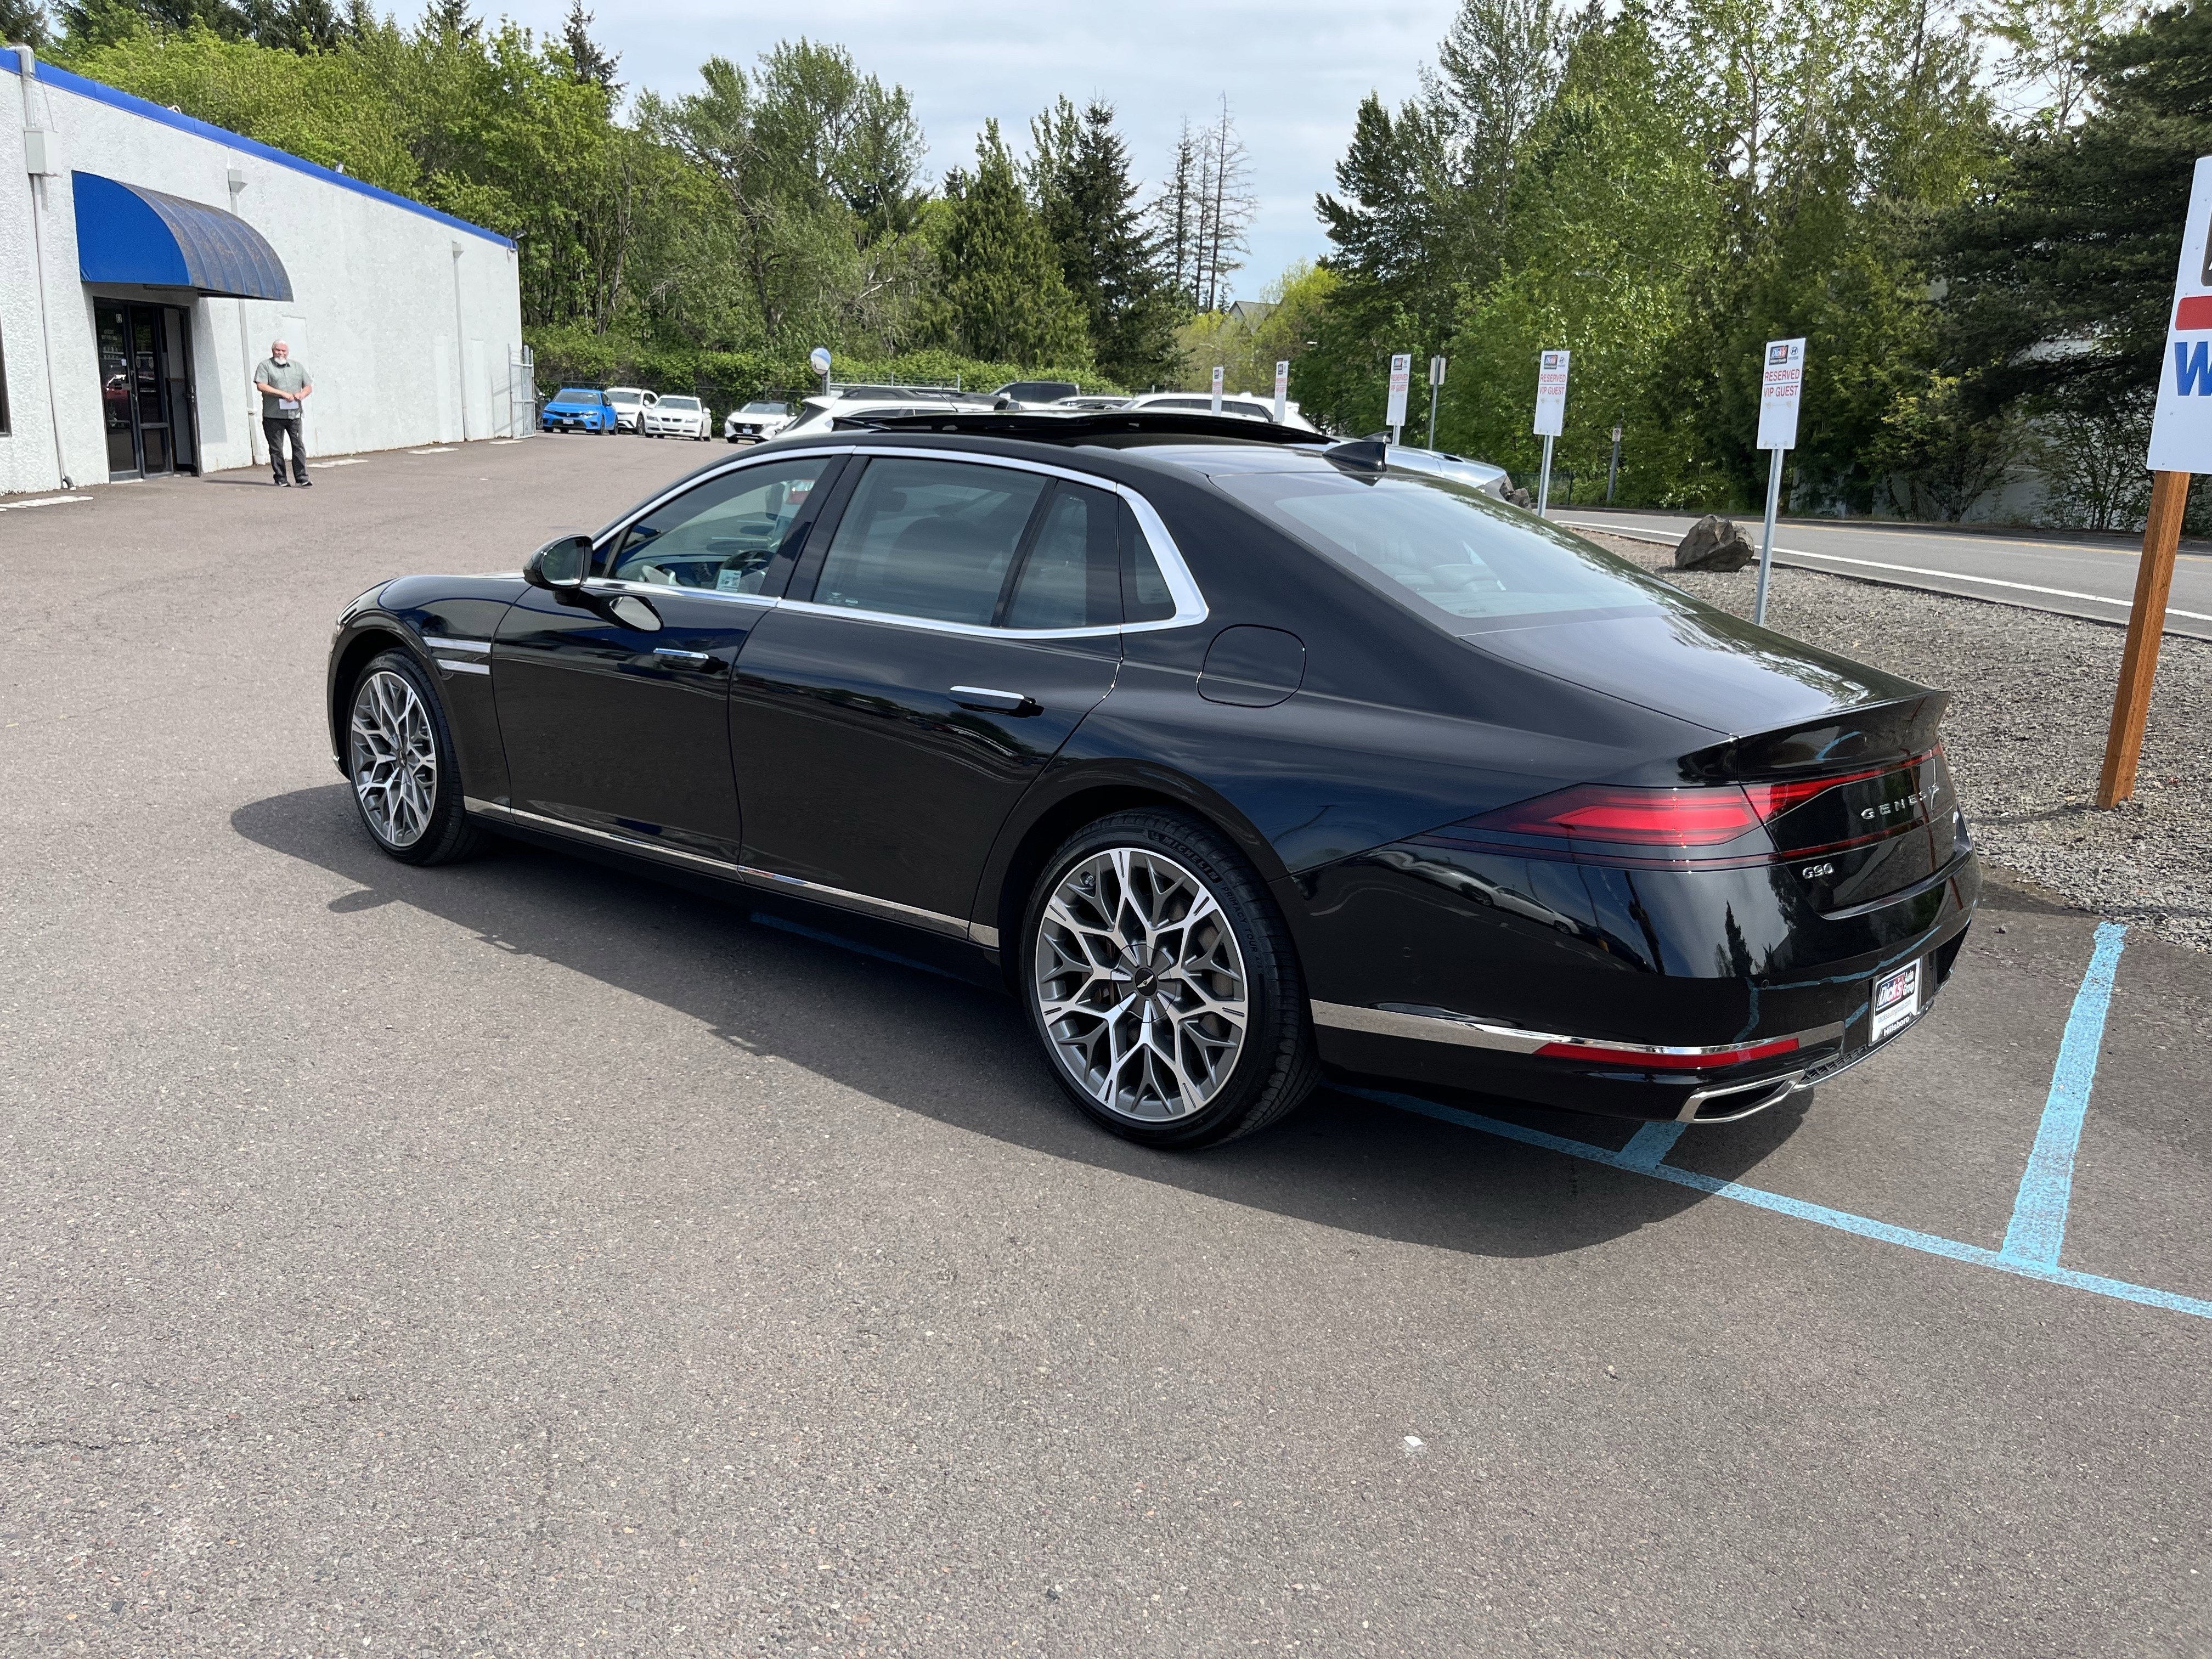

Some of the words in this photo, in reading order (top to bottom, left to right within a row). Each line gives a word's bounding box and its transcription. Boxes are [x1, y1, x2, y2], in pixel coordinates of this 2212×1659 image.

[1540, 374, 1566, 382] RESERVED
[1764, 369, 1800, 382] RESERVED
[1539, 386, 1547, 394] VIP
[1548, 386, 1565, 395] GUEST
[1763, 387, 1774, 397] VIP
[1775, 385, 1799, 397] GUEST
[1802, 862, 1835, 879] G90
[1163, 836, 1219, 880] MICHELIN
[1222, 886, 1251, 926] PRIMACY
[1244, 927, 1258, 953] TOUR
[1883, 1015, 1910, 1037] Hillsboro
